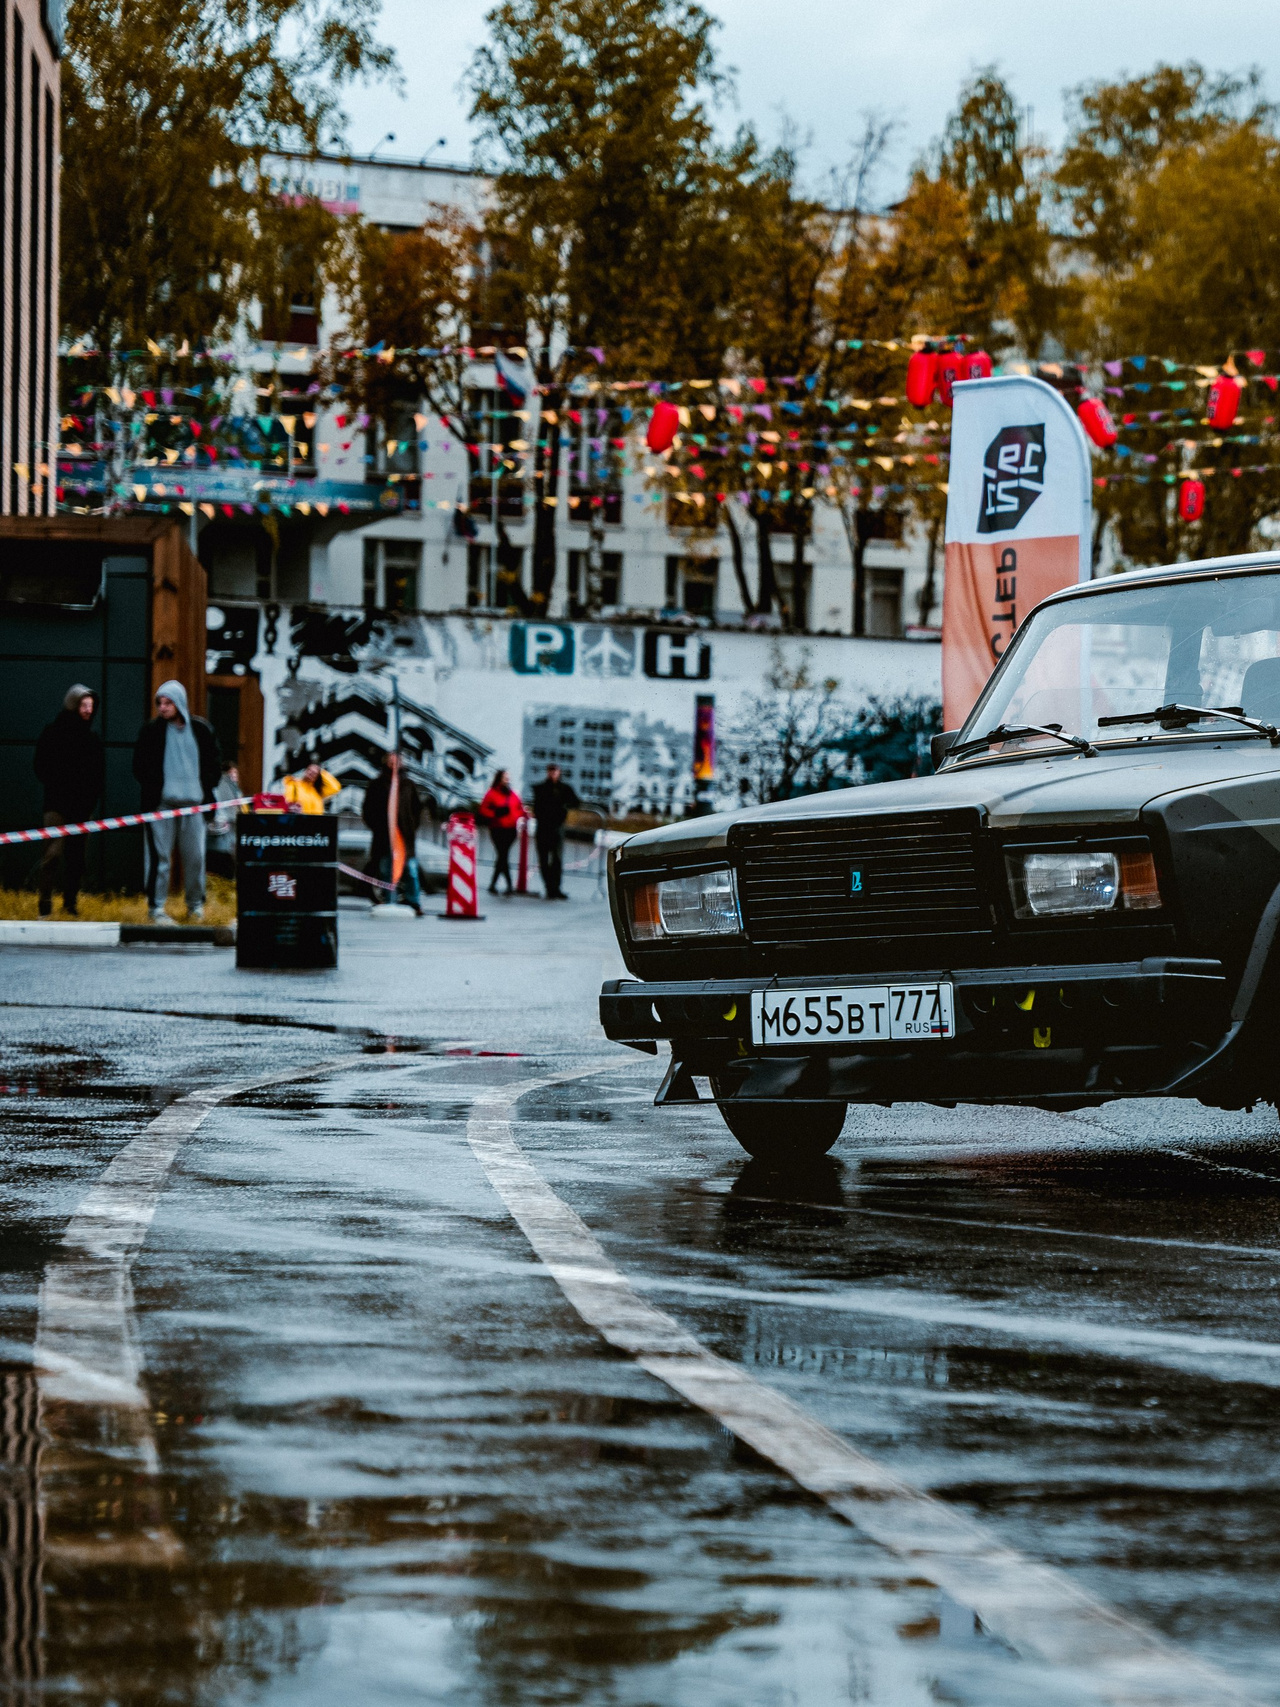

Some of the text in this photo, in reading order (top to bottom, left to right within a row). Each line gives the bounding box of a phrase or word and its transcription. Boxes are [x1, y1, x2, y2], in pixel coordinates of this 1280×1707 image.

[525, 626, 565, 668] P
[656, 634, 701, 677] H
[761, 989, 940, 1037] М655ВТ 777
[905, 1022, 930, 1034] RUS
